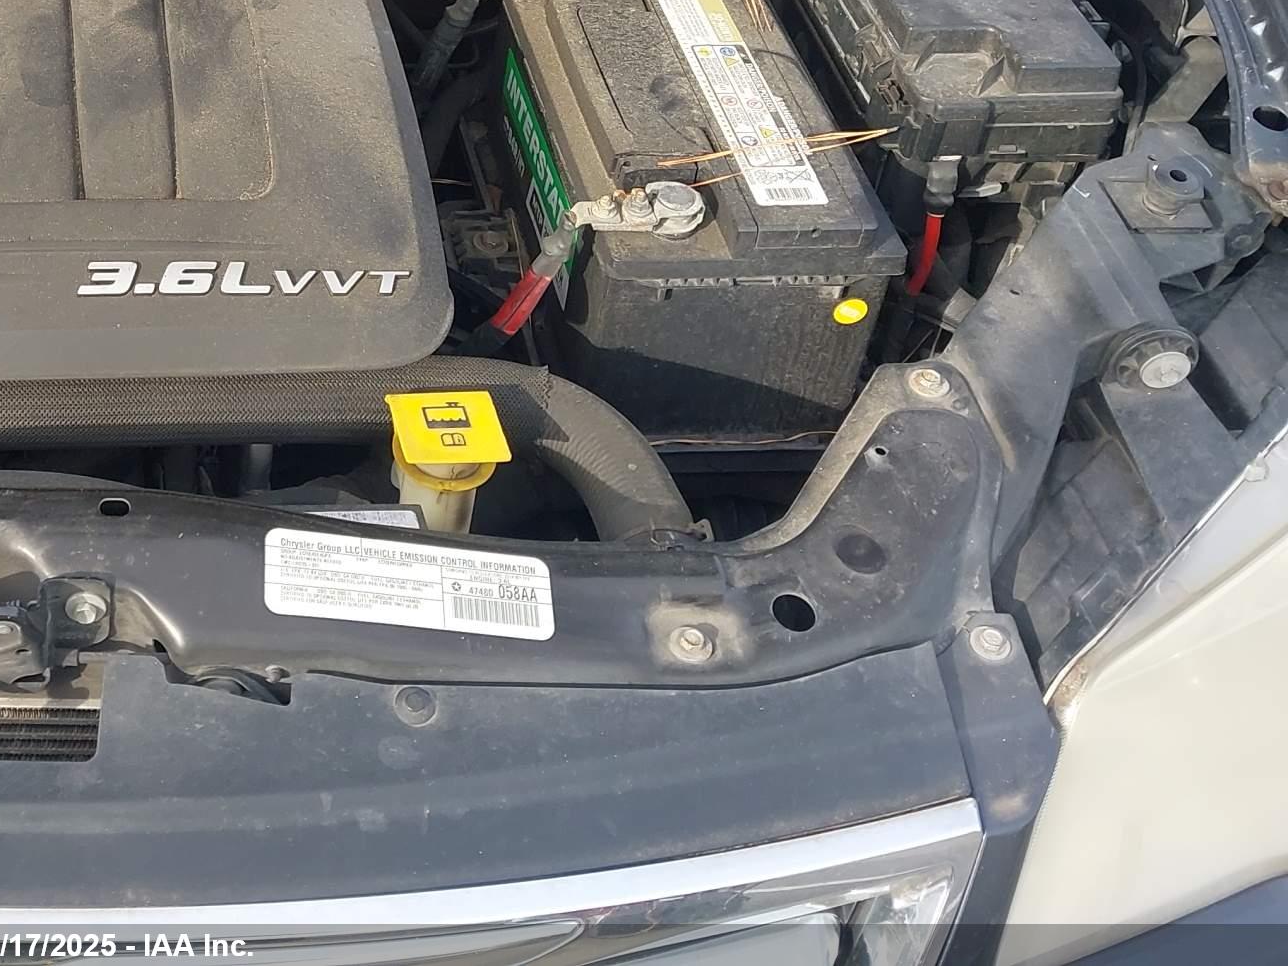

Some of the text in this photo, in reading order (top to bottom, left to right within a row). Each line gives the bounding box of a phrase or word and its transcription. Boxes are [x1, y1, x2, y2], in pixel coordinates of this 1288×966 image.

[76, 261, 411, 295] 3.6L VVT
[280, 538, 314, 550] Chrysler
[317, 543, 341, 553] Group
[345, 545, 360, 554] LLC
[363, 547, 397, 559] VEHICLE
[400, 551, 438, 563] EMISSION
[441, 556, 478, 568] CONTROL
[480, 561, 536, 574] INFORMATION
[498, 584, 537, 602] 058AA
